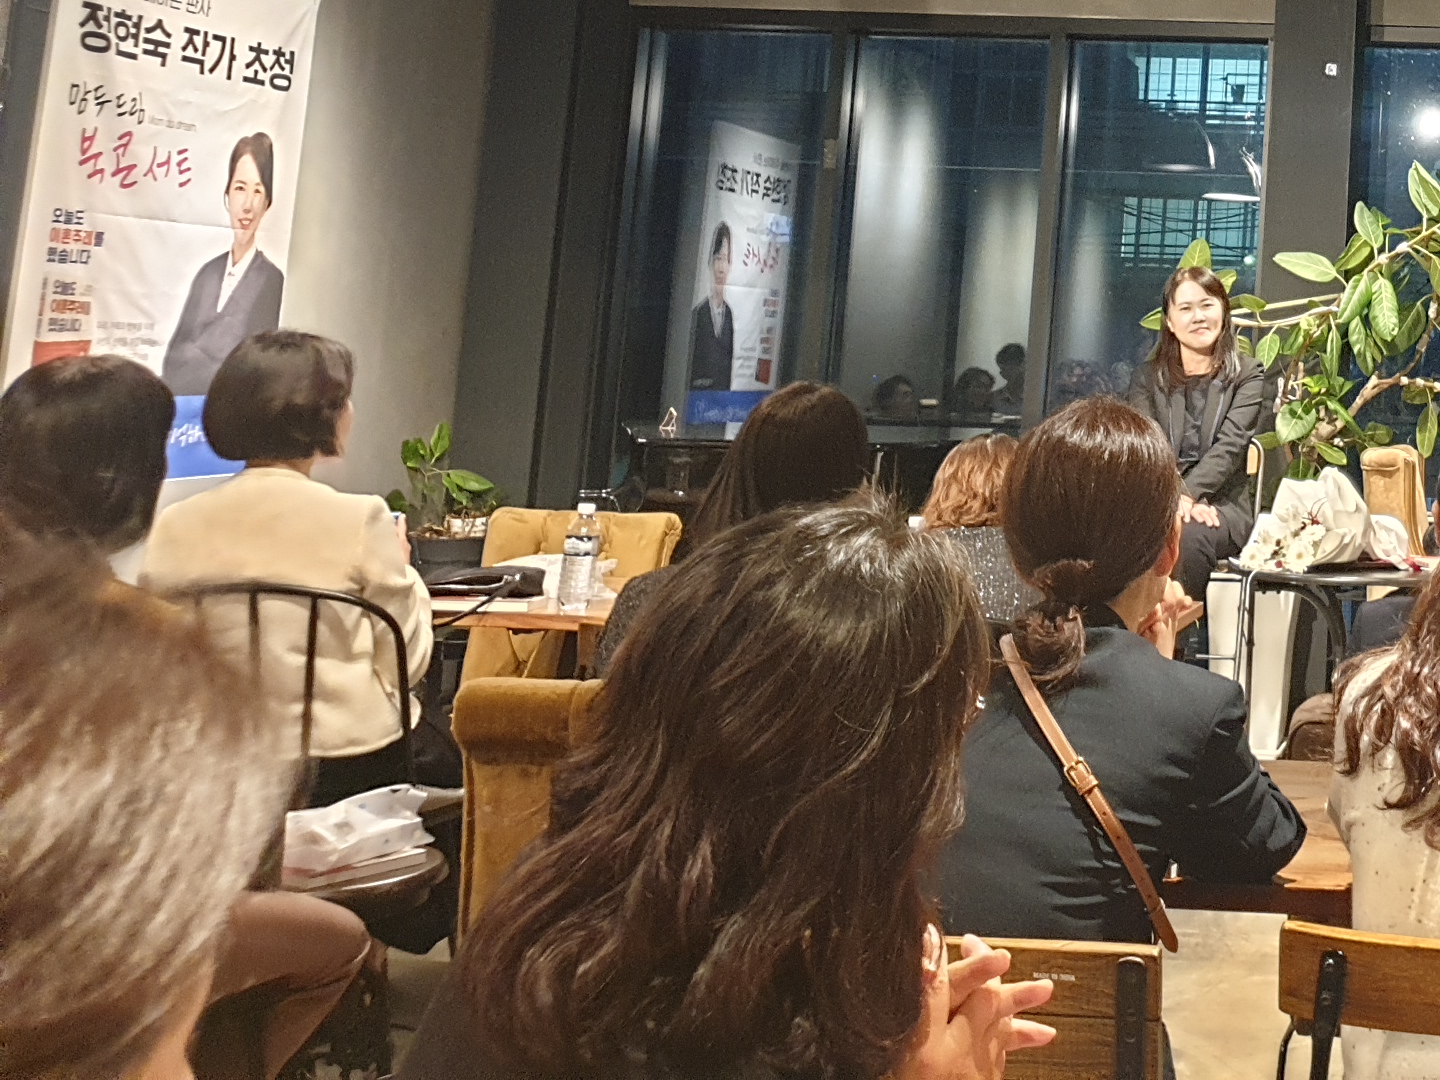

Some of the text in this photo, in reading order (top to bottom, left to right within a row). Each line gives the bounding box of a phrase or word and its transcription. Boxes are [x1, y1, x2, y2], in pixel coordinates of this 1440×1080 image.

[78, 0, 295, 92] 정현숙 작가 초청
[51, 207, 85, 225] 오늘도
[46, 246, 92, 265] 했습니다
